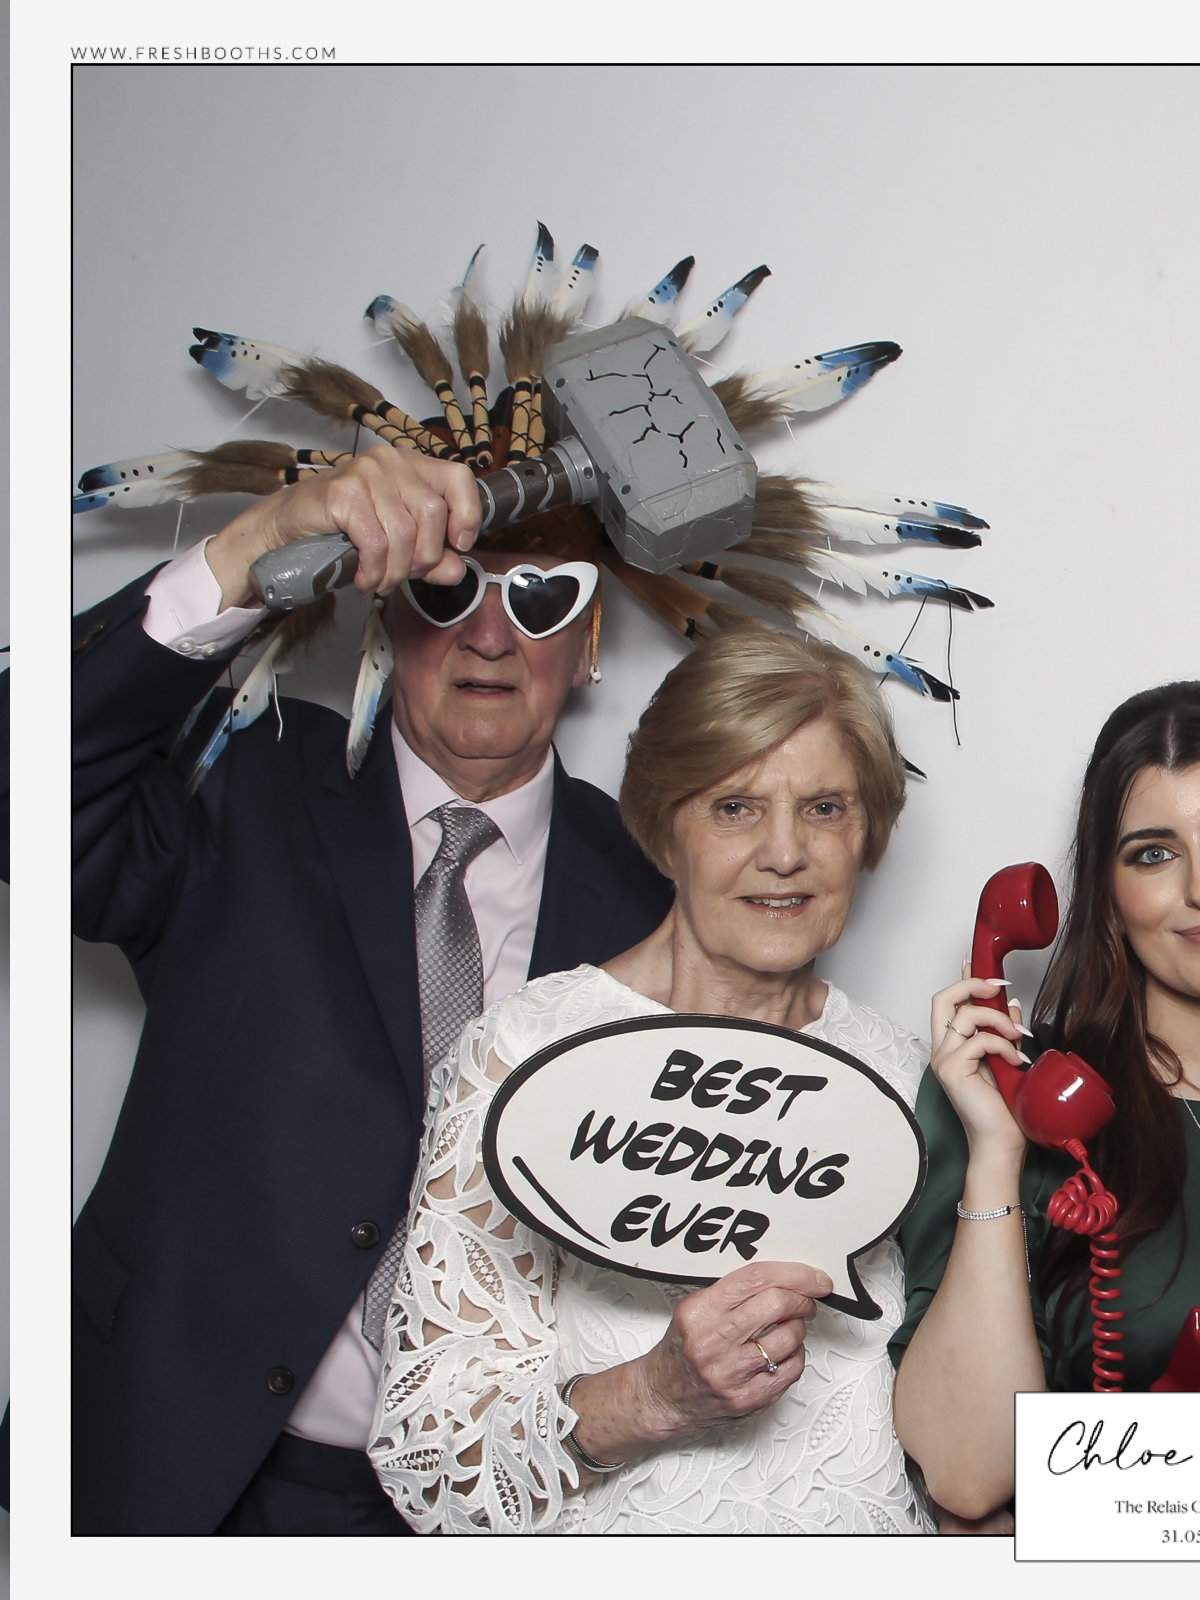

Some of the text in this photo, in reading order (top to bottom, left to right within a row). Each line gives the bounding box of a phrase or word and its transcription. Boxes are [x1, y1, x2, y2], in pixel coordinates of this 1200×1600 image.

[650, 1049, 828, 1121] BEST
[569, 1109, 850, 1199] WEDDING
[610, 1194, 770, 1261] EVER
